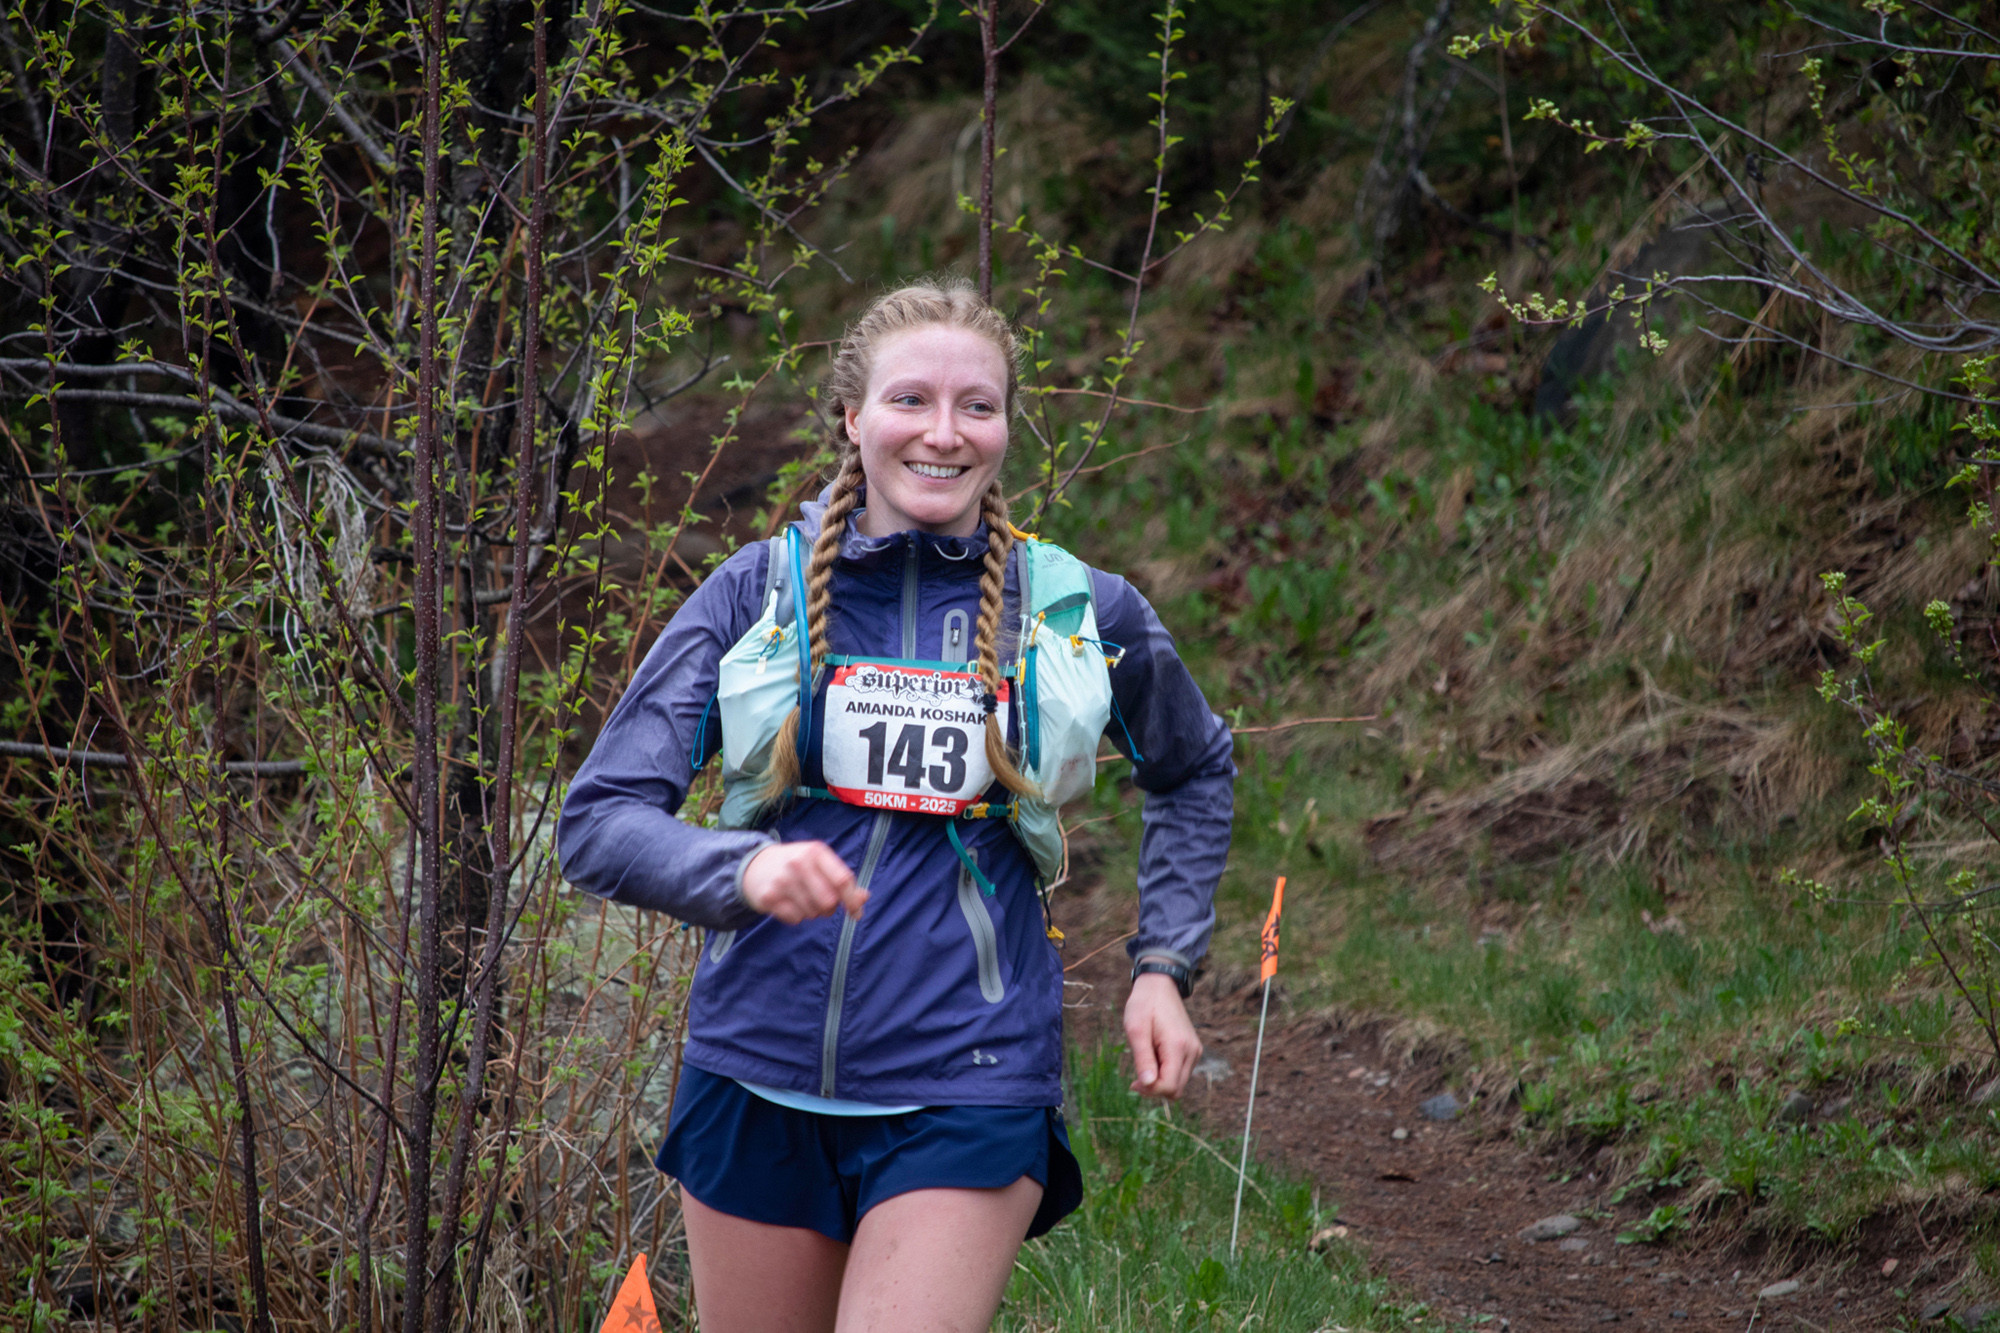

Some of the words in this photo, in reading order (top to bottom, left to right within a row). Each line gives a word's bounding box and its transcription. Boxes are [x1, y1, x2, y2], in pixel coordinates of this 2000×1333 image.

[845, 701, 916, 718] AMANDA
[920, 708, 988, 726] KOSHAK
[859, 721, 969, 794] 143
[864, 792, 907, 809] 50KM
[919, 797, 957, 814] 2025
